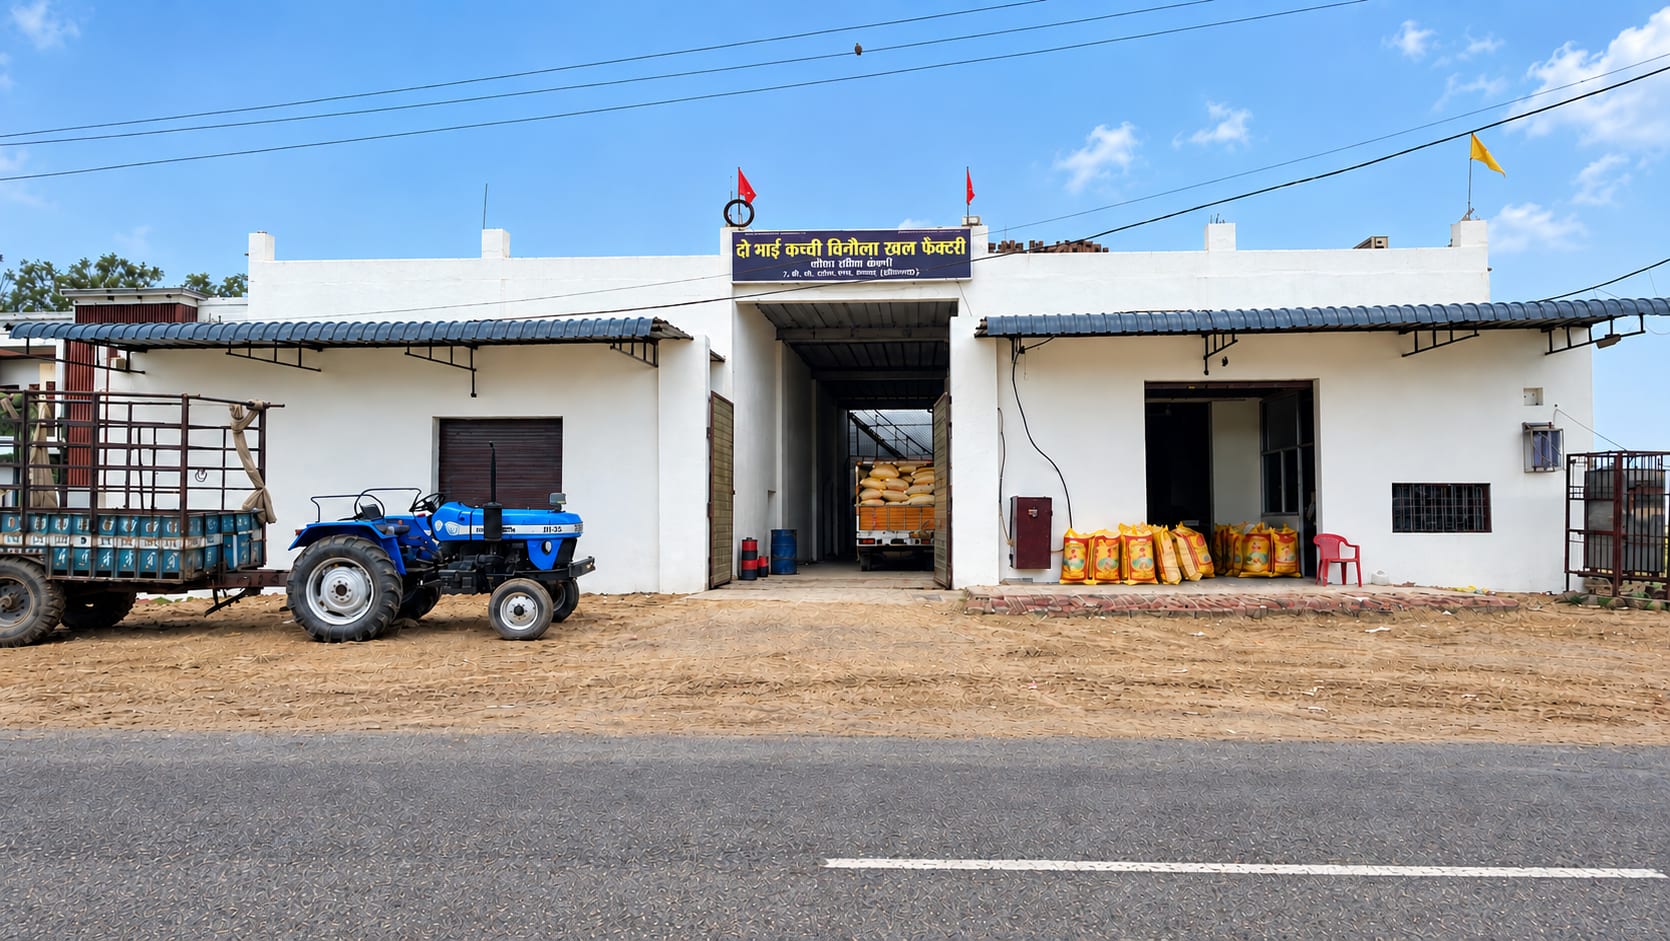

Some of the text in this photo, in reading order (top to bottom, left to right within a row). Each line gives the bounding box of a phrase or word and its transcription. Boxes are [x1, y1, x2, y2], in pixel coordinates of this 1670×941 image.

[736, 239, 751, 259] दो
[754, 238, 782, 260] भाई
[883, 241, 918, 256] खल
